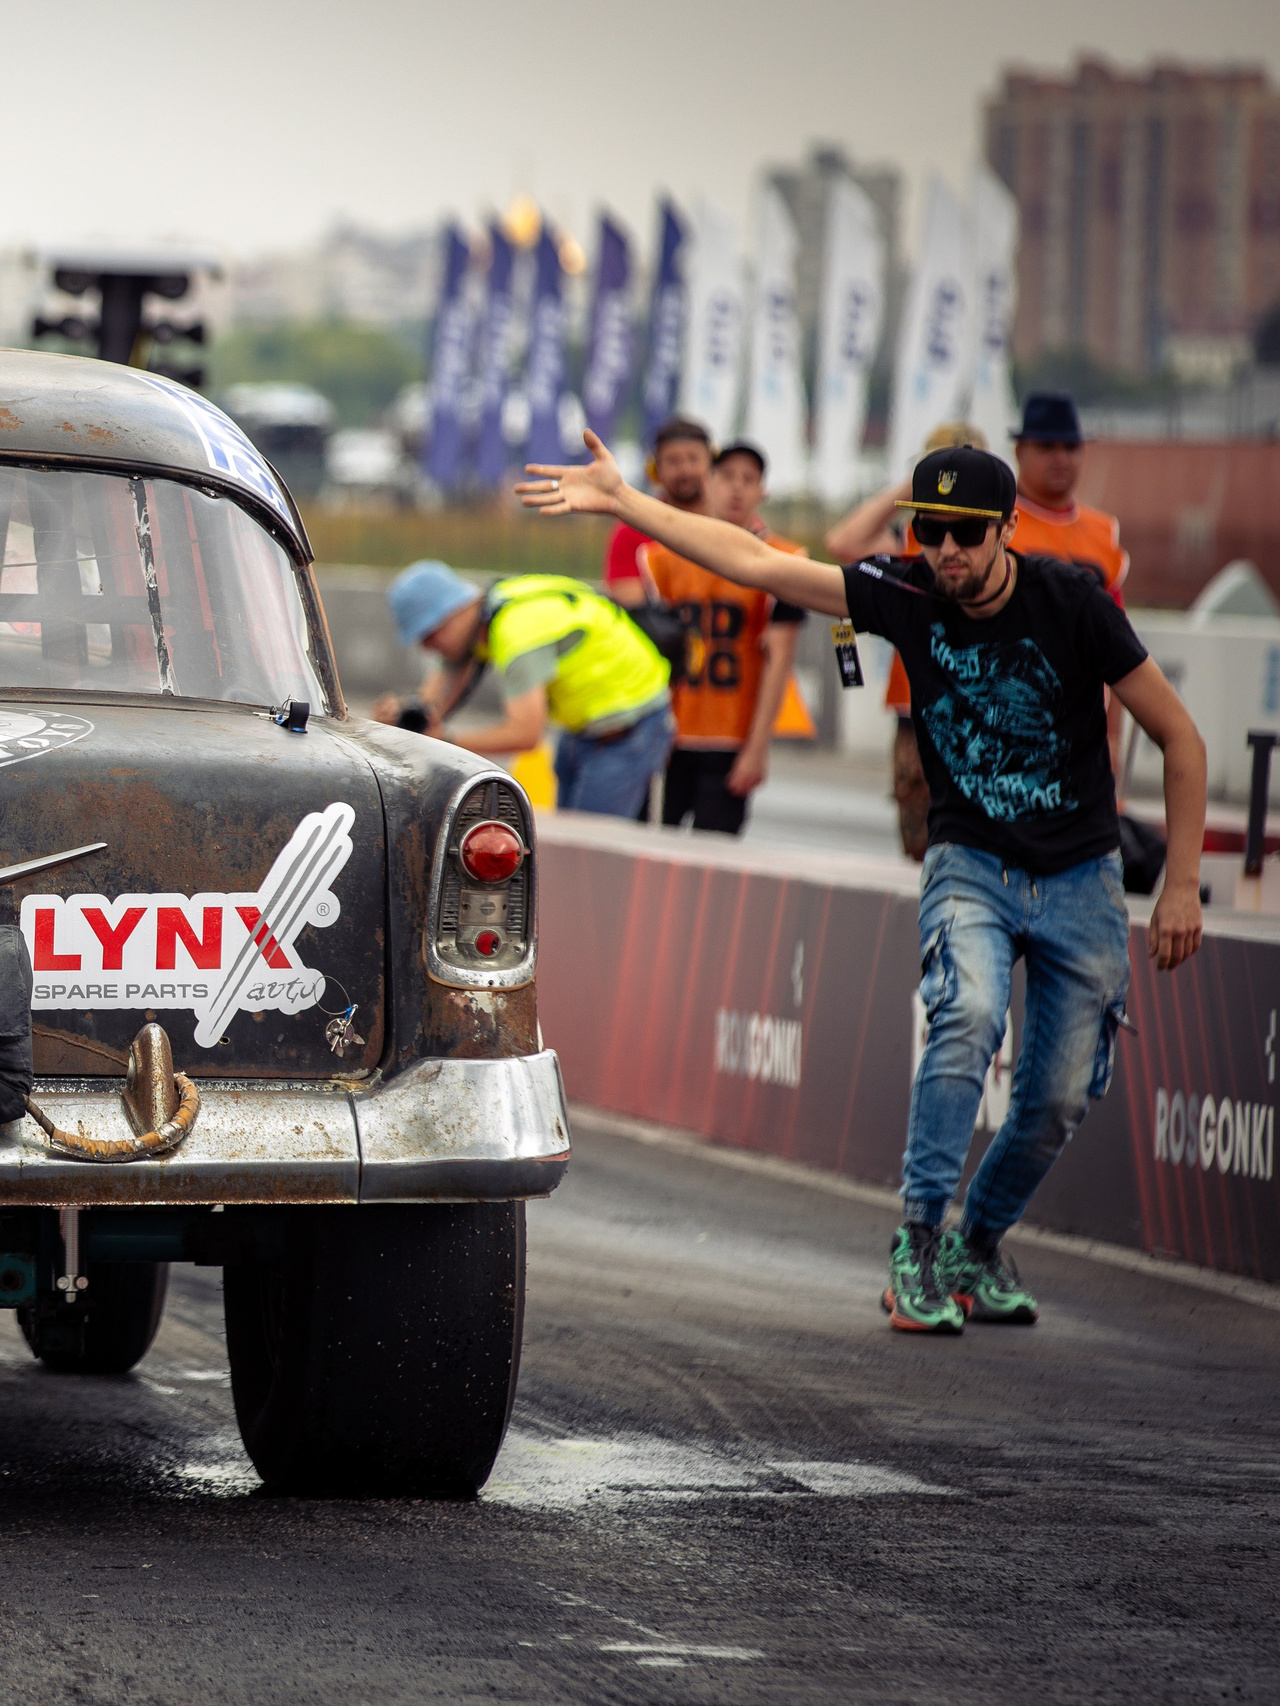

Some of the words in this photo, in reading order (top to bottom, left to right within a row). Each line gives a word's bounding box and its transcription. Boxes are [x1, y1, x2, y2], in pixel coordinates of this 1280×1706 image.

[33, 906, 293, 971] LYNX
[34, 984, 119, 999] SPARE
[126, 983, 208, 999] PARTS
[1154, 1087, 1274, 1181] ROSGONKI
